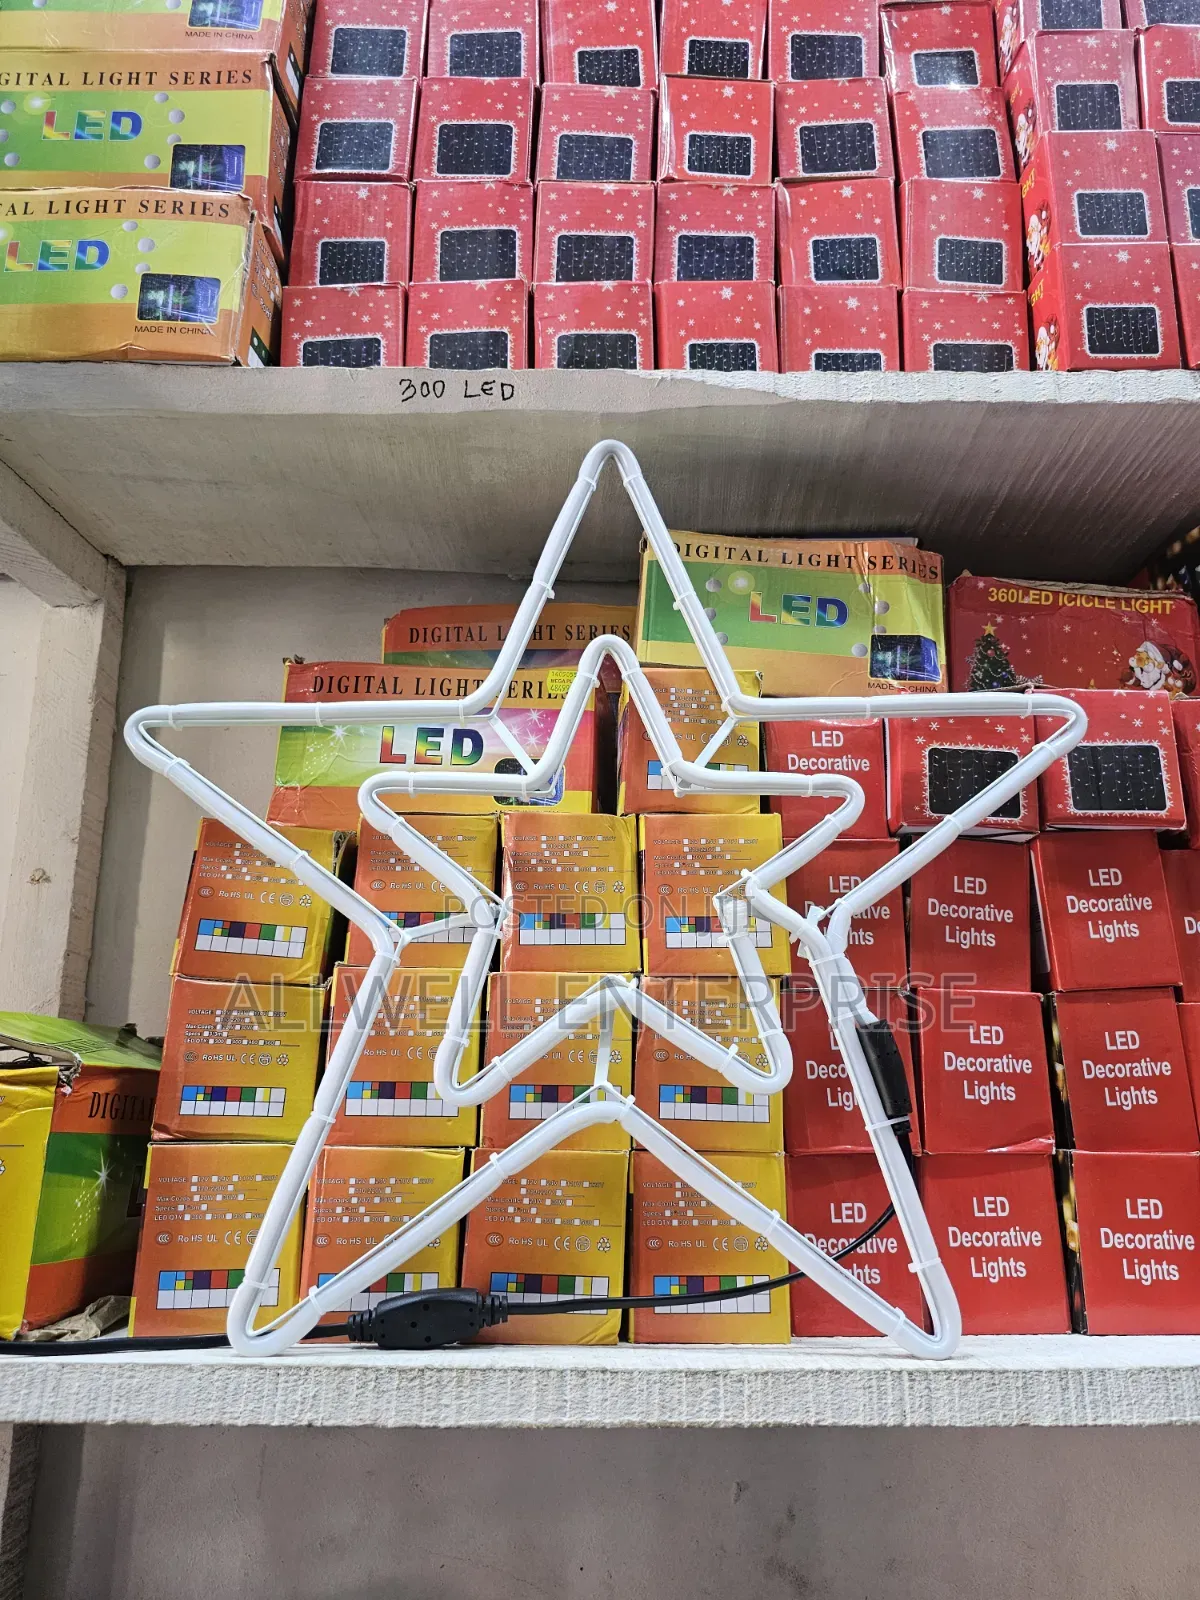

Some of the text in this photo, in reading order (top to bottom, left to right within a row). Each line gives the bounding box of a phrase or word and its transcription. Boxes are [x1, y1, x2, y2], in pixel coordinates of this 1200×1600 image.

[185, 30, 213, 38] MADE
[228, 32, 254, 40] CHINA
[82, 71, 158, 86] LIGHT
[168, 69, 253, 85] SERIES
[41, 110, 143, 141] LED
[47, 199, 127, 215] LIGHT
[138, 200, 231, 218] SERIES
[3, 239, 111, 272] LED
[134, 325, 213, 336] MADE IN CHINA
[399, 379, 514, 402] 300 LED
[781, 552, 856, 569] LIGHT
[867, 555, 938, 579] SERIES
[749, 591, 849, 628] LED
[988, 587, 1174, 615] 360LED ICICLE LIGHT
[409, 626, 488, 644] DIGITAL
[497, 625, 556, 641] LHT
[313, 675, 403, 694] DIGITAL
[867, 682, 895, 690] MADE
[908, 685, 938, 693] CHINA
[379, 726, 484, 766] LED
[811, 730, 844, 747] LED
[787, 753, 870, 771] Decorative
[954, 875, 987, 895] LED
[1088, 867, 1122, 887] LED
[927, 898, 1014, 923] Decorative
[1066, 893, 1153, 914] Decorative
[945, 925, 996, 949] Lights
[1088, 919, 1140, 943] Lights
[969, 1025, 1004, 1045] LED
[1104, 1030, 1140, 1050] LED
[944, 1051, 1032, 1074] Decorative
[1082, 1057, 1172, 1079] Decorative
[963, 1080, 1016, 1105] Lights
[1104, 1086, 1158, 1111] Lights
[830, 1202, 867, 1223] LED
[972, 1196, 1010, 1217] LED
[1125, 1198, 1163, 1219] LED
[947, 1226, 1042, 1247] Decorative
[1100, 1227, 1196, 1251] Decorative
[970, 1257, 1027, 1283] Lights
[1122, 1258, 1180, 1286] Lights
